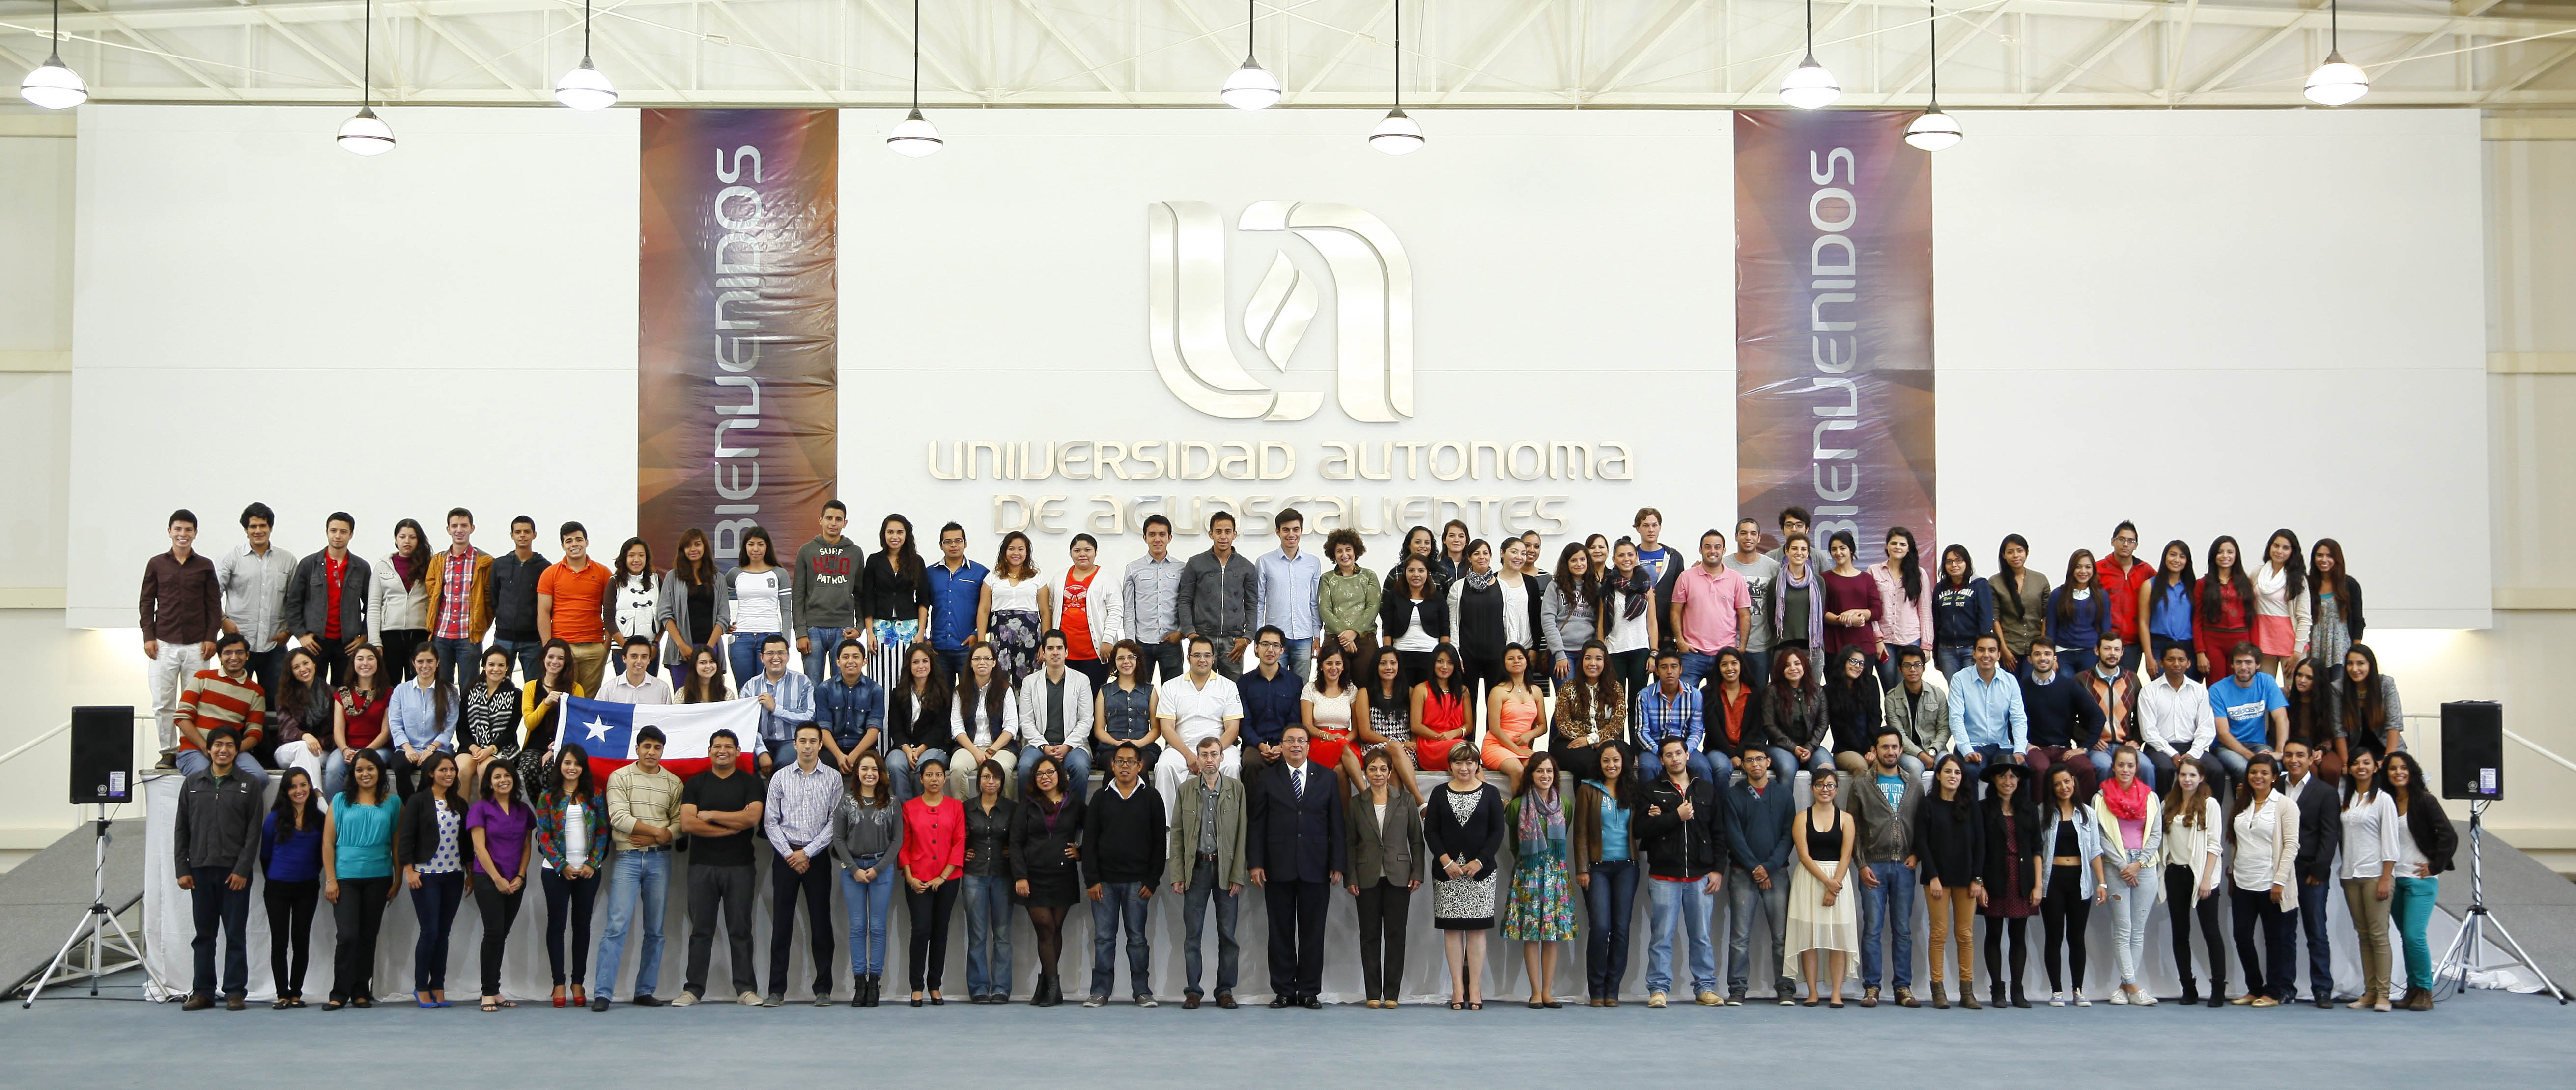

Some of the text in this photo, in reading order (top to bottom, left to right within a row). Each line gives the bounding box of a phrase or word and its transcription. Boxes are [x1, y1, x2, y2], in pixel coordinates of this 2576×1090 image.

[714, 144, 762, 559] BIENVENIDOS
[1809, 147, 1859, 561] BIENVENIDOS
[927, 440, 1634, 481] UNIVERSIDAD AUTONOMA
[993, 495, 1065, 535] DE
[819, 547, 844, 556] SURF
[766, 577, 776, 588] B
[816, 573, 848, 584] PATROL
